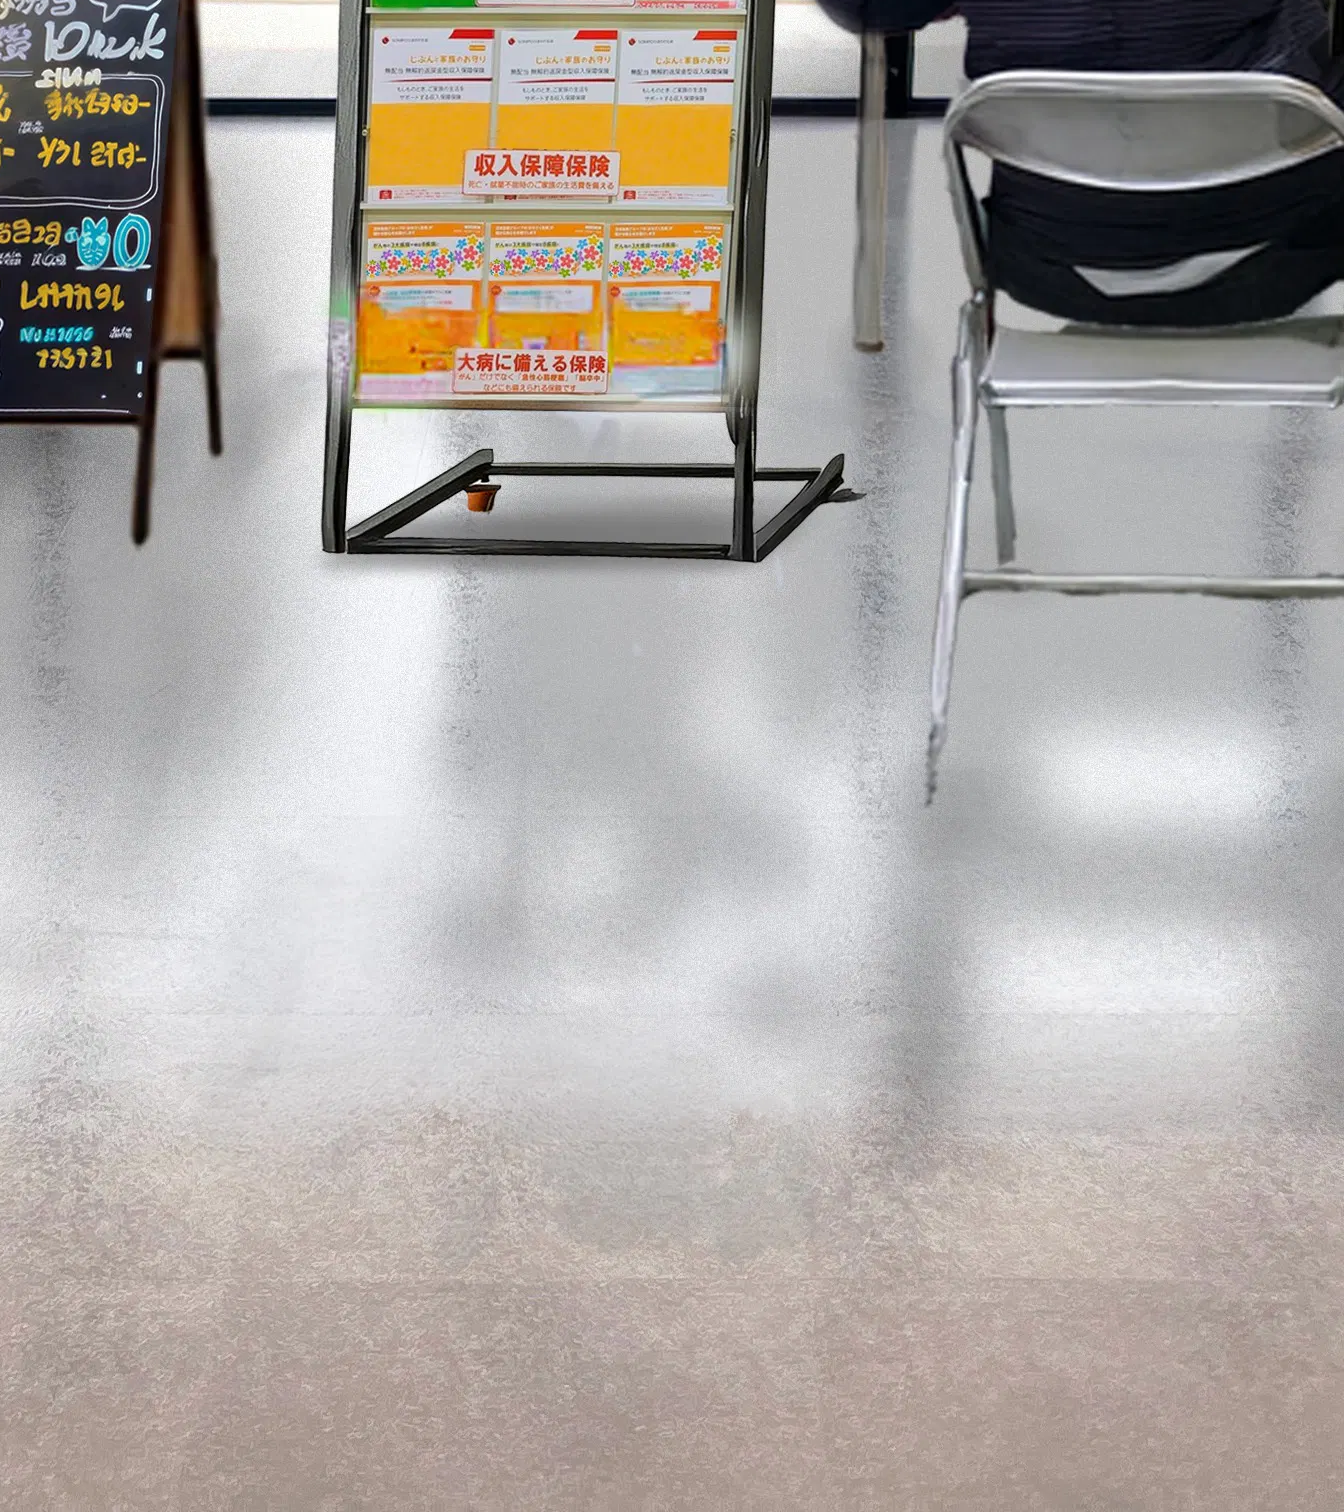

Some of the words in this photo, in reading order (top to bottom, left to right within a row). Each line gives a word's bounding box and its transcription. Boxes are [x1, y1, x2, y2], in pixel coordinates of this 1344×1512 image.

[474, 153, 611, 178] 収入保障保険
[458, 352, 606, 374] 大病に備える保険
